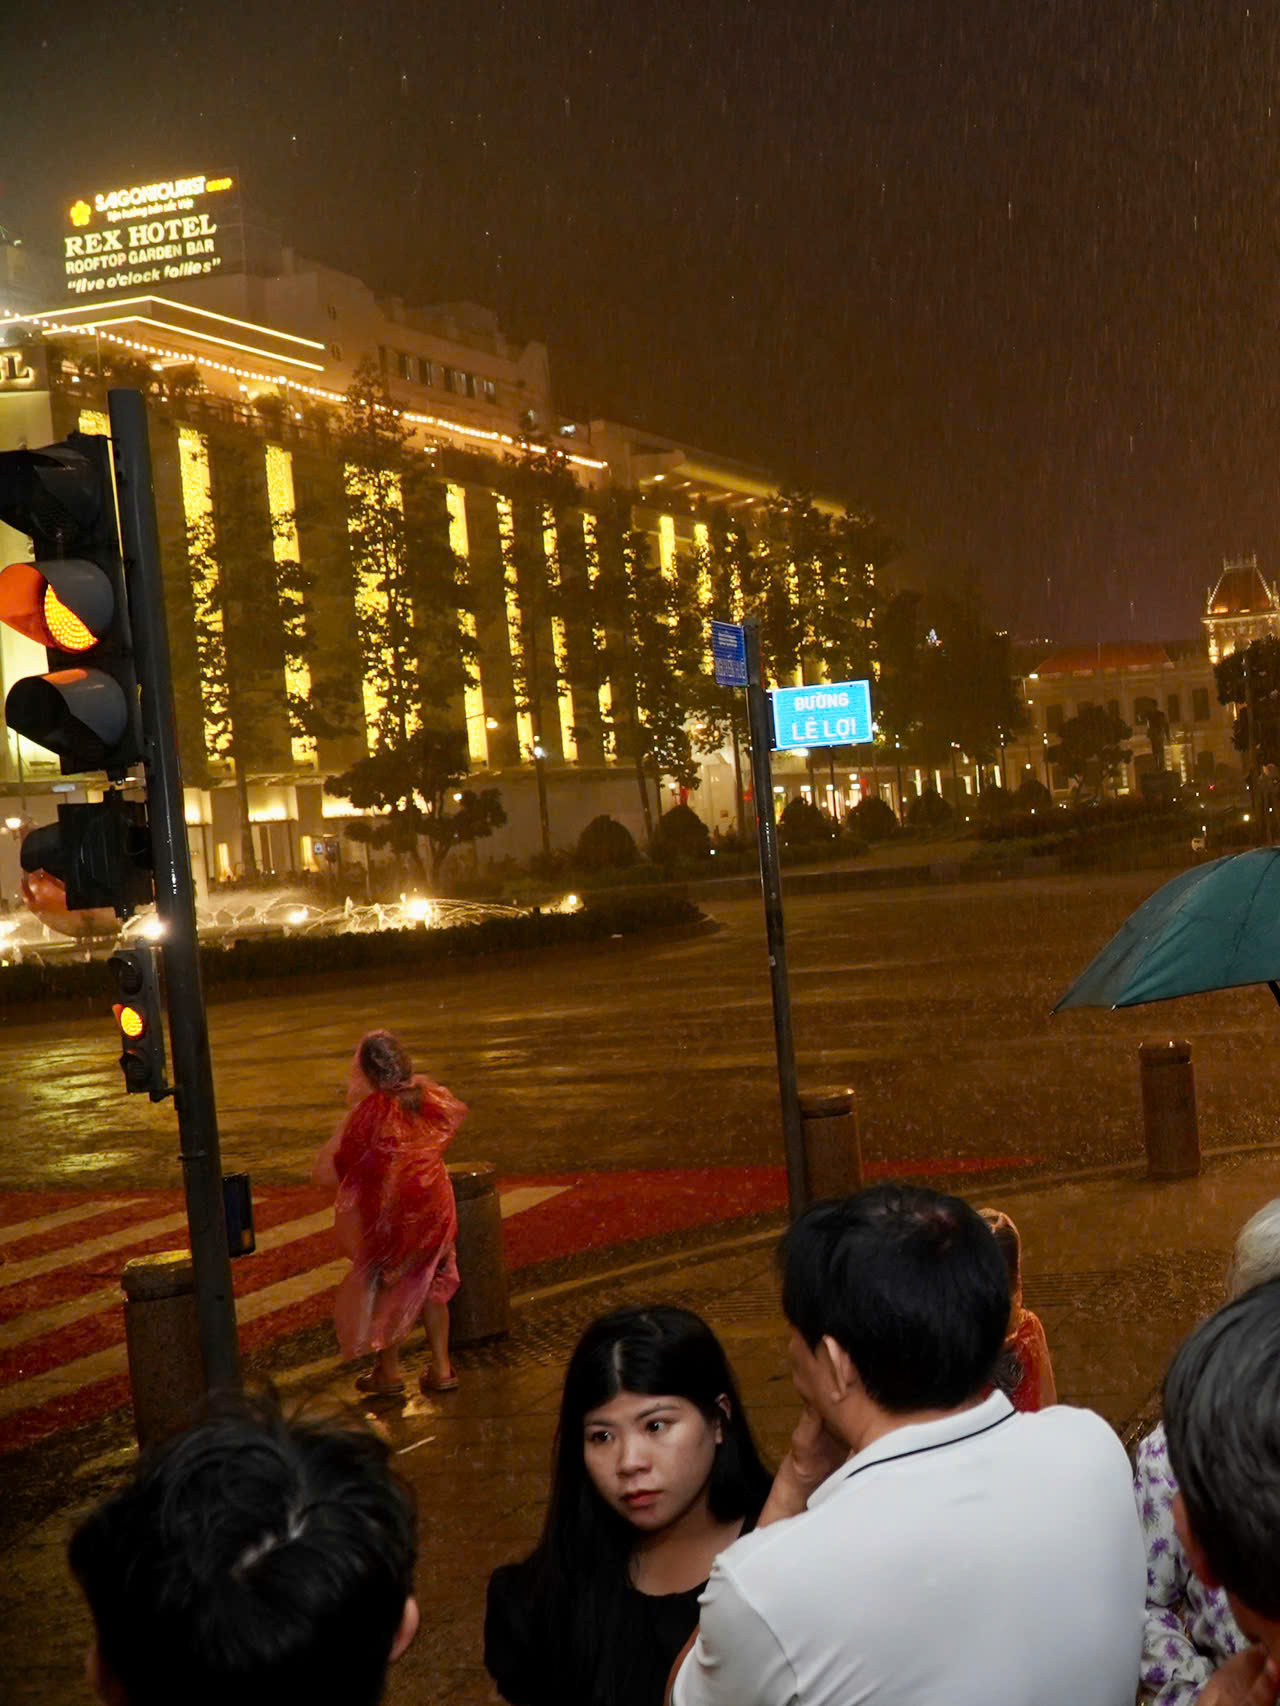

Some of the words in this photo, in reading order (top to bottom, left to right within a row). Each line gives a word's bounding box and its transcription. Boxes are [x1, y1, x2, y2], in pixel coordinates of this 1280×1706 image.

[64, 229, 123, 258] REX
[128, 214, 217, 247] HOTEL
[65, 253, 126, 274] ROOFTOP
[128, 243, 183, 264] GARDEN
[186, 239, 215, 256] BAR
[794, 691, 849, 712] ĐƯỜNG
[792, 716, 819, 740] LÊ
[824, 717, 857, 740] LỢI
